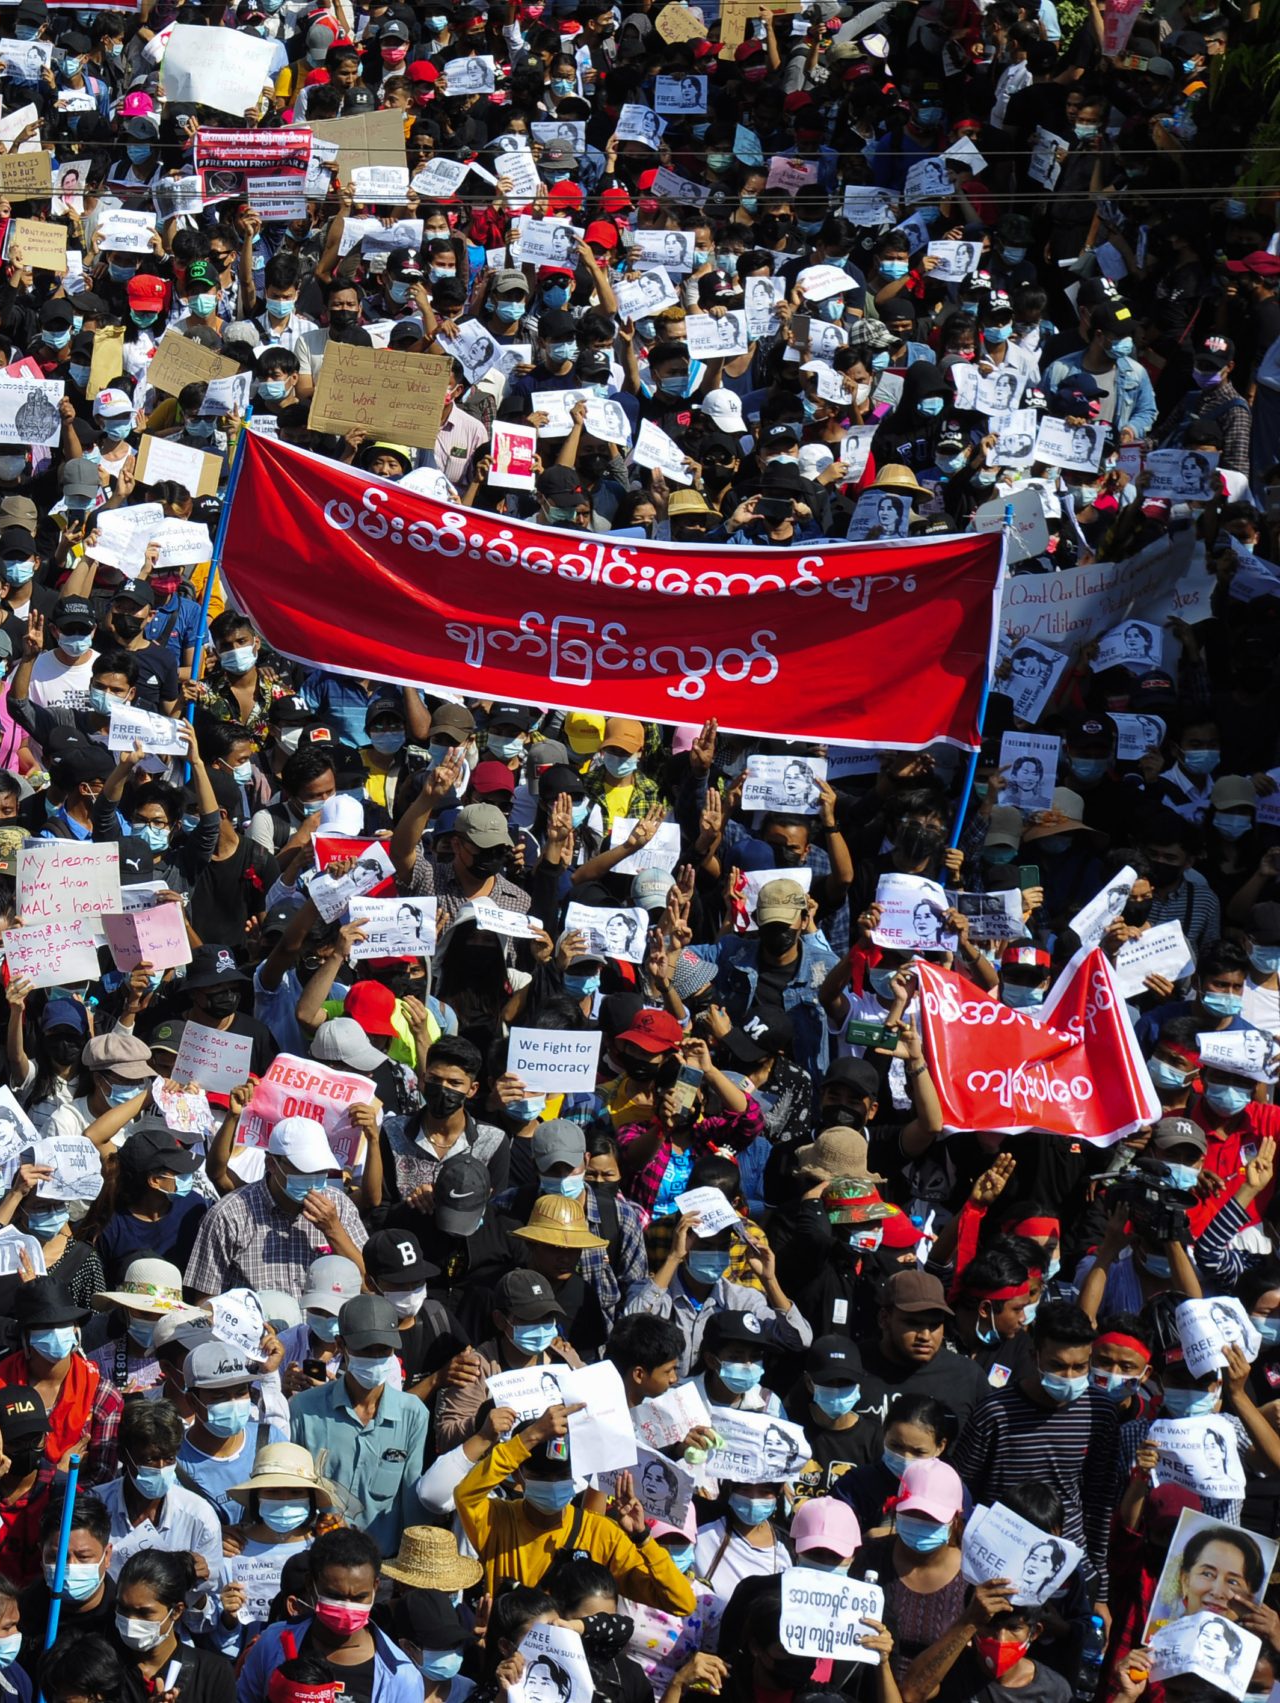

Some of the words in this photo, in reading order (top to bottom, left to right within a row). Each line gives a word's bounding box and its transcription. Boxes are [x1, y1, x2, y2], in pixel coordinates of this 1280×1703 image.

[337, 345, 360, 369] We
[372, 346, 407, 375] Voted
[333, 370, 372, 389] Respect
[382, 377, 401, 392] Our
[406, 379, 432, 395] Votes
[328, 389, 345, 404] We
[352, 392, 376, 407] Want
[113, 724, 141, 736] FREE
[745, 784, 773, 795] FREE
[22, 854, 46, 879] My
[51, 852, 102, 870] dreams
[21, 879, 51, 898] higher
[59, 878, 90, 889] than
[73, 897, 116, 914] height
[479, 907, 503, 920] FREE
[877, 928, 902, 938] FREE
[370, 946, 389, 954] AUNG
[520, 1040, 539, 1051] We
[542, 1039, 572, 1056] Fight
[575, 1041, 592, 1053] for
[517, 1058, 590, 1075] Democracy
[268, 1063, 358, 1104] RESPECT
[283, 1097, 325, 1126] OUR
[398, 1242, 417, 1265] B
[1185, 1338, 1215, 1359] FREE
[7, 1400, 35, 1416] FILA
[715, 1449, 750, 1465] FREE
[1157, 1457, 1195, 1476] FREE
[969, 1536, 1007, 1571] FREE
[529, 1631, 550, 1645] FREE
